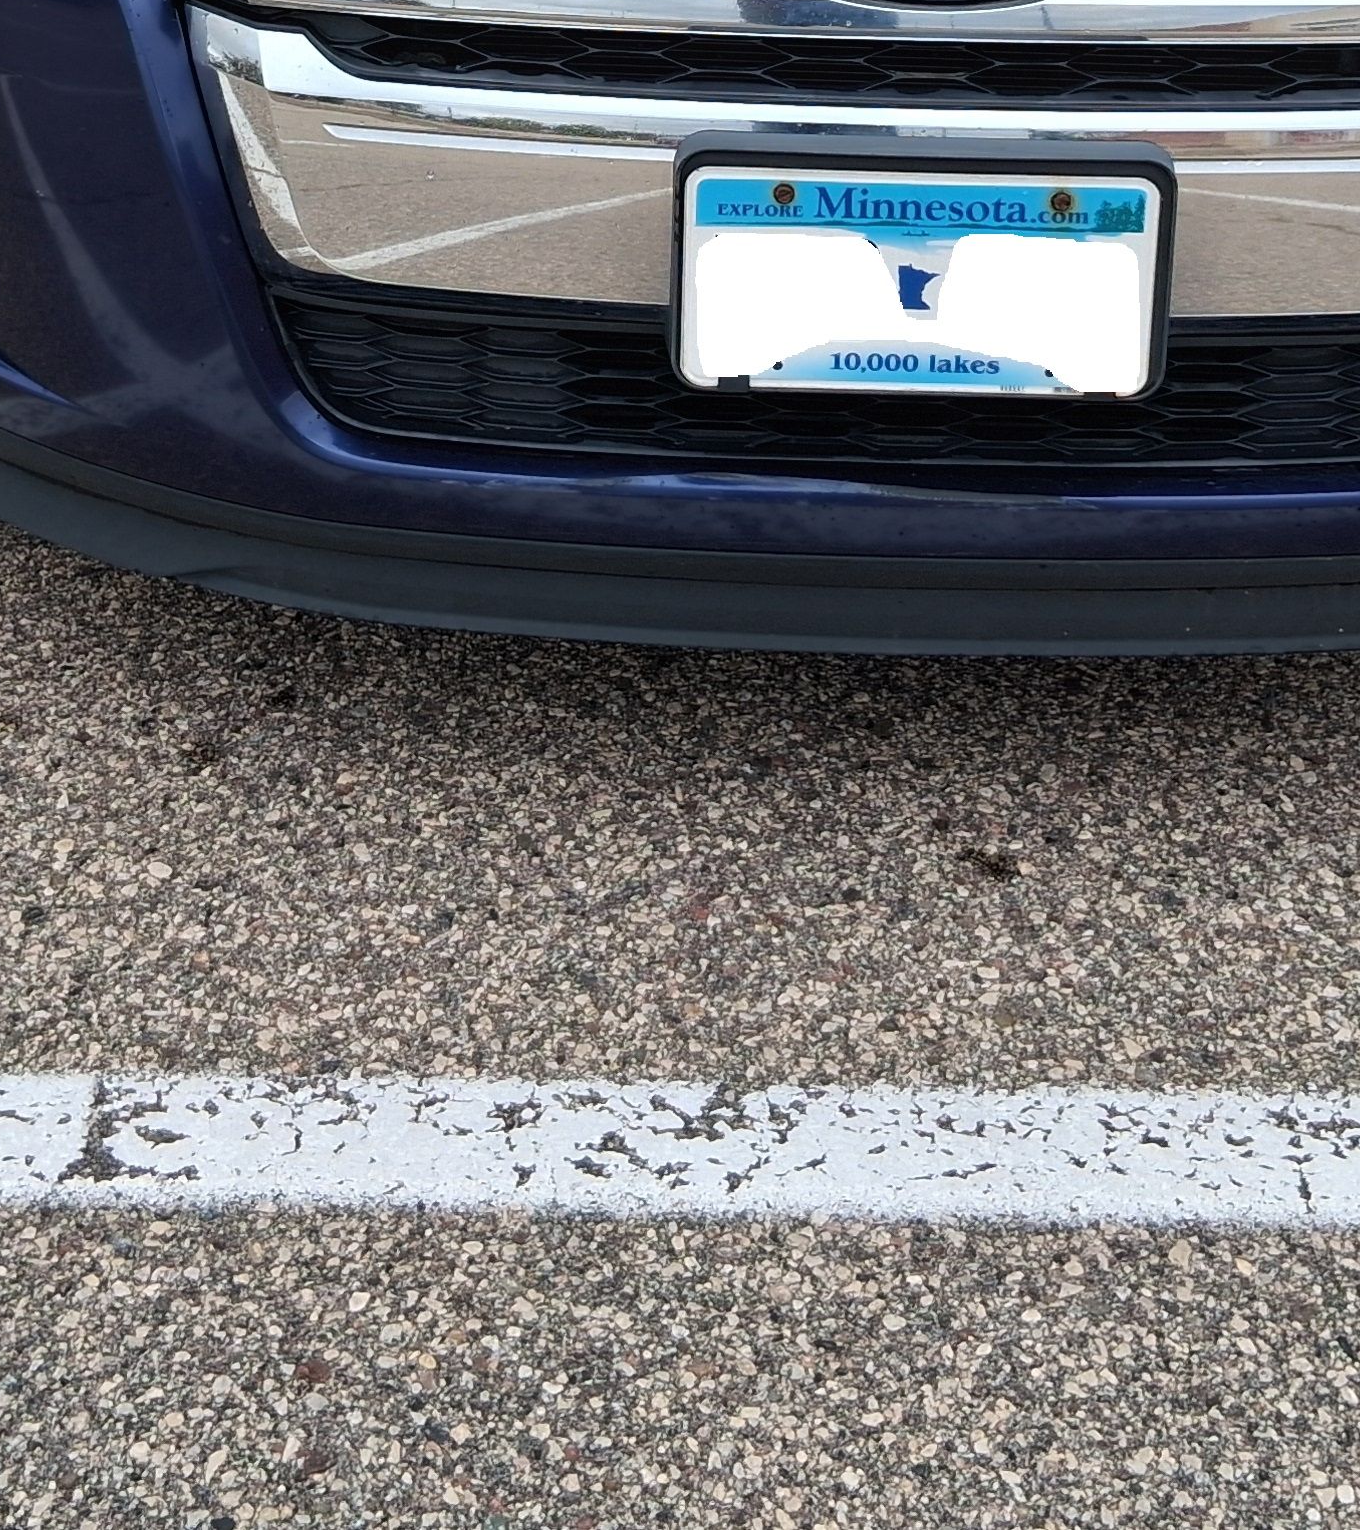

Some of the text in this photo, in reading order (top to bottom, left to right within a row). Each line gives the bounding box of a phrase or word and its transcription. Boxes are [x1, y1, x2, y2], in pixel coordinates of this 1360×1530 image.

[717, 202, 804, 218] EXPLORE
[830, 352, 1000, 375] 10,000 lakes
